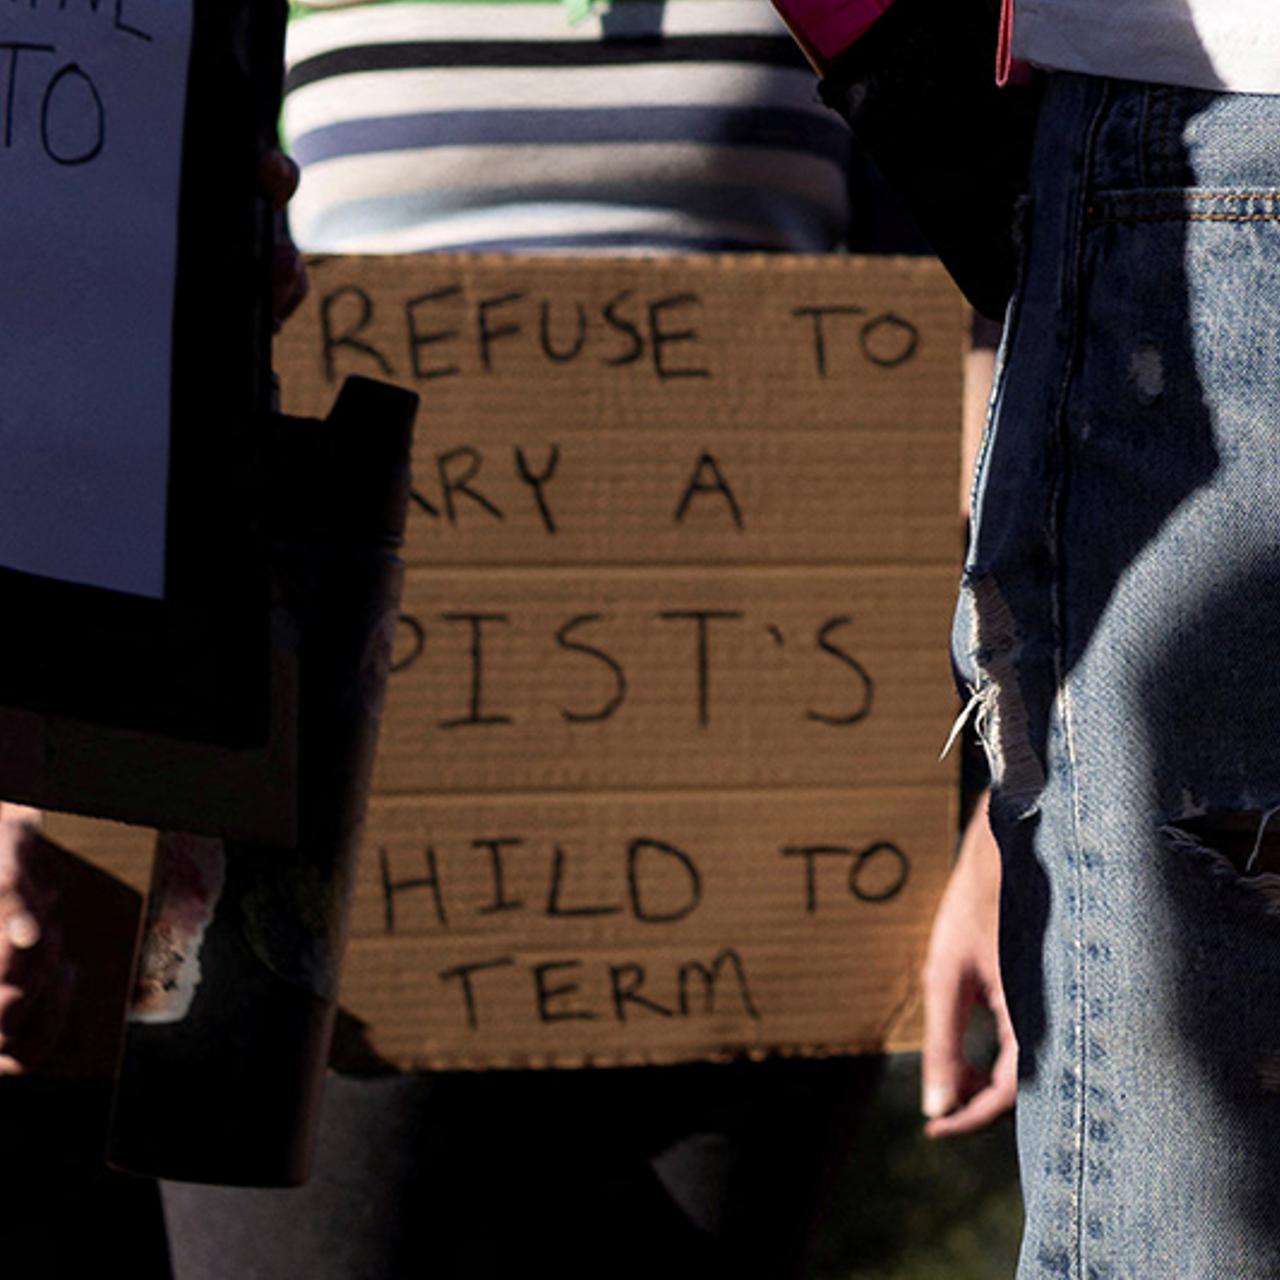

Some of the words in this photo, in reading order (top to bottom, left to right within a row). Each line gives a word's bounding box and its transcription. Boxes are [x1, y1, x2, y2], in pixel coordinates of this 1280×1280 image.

[320, 285, 712, 382] REFUSE
[795, 304, 917, 378] TO
[676, 453, 744, 530] A
[782, 840, 909, 912] TO
[440, 948, 761, 1030] TERM
